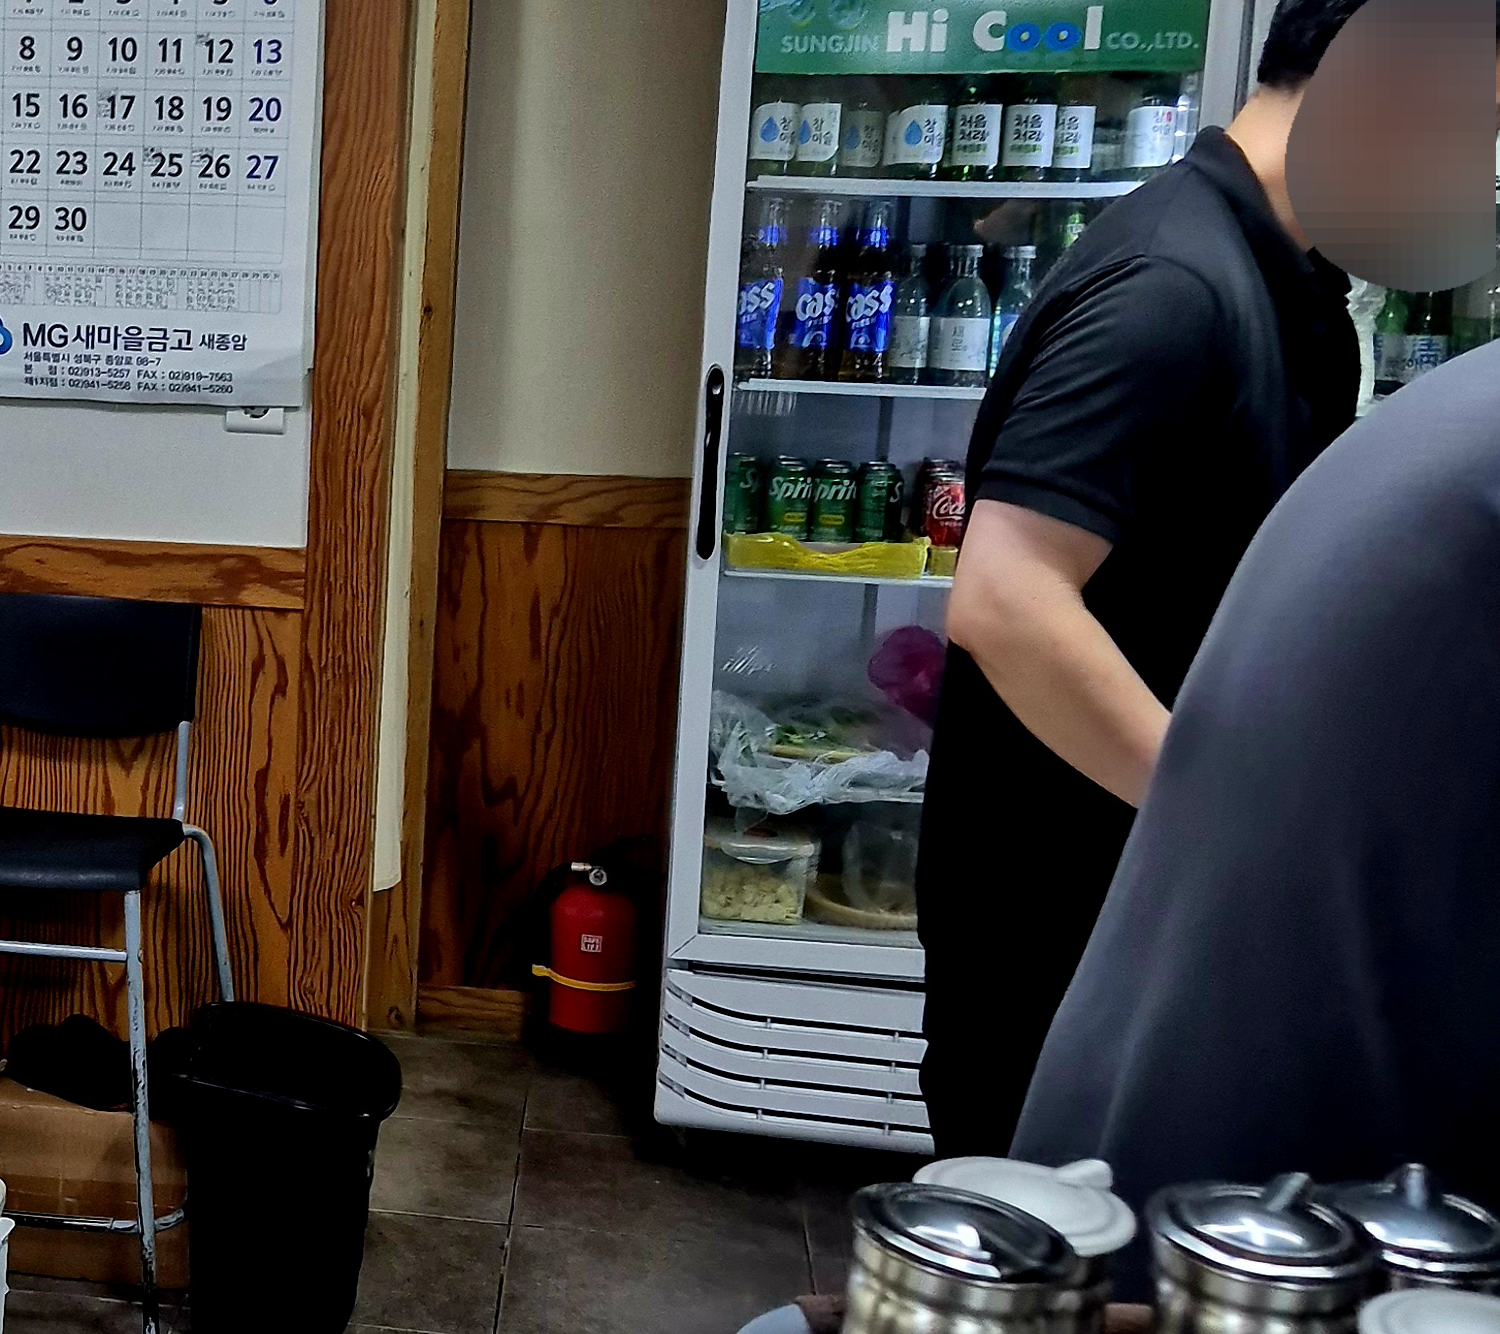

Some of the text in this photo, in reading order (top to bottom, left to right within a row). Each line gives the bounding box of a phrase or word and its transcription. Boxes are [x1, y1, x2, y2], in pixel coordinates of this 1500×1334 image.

[781, 34, 879, 54] SUNGJIN
[886, 8, 950, 54] Hi
[973, 6, 1103, 53] Cool
[18, 35, 36, 61] 8
[66, 35, 83, 62] 9
[107, 36, 138, 63] 10
[158, 37, 183, 64] 11
[204, 38, 234, 64] 12
[252, 38, 283, 65] 13
[11, 92, 41, 118] 15
[58, 93, 89, 119] 16
[107, 93, 136, 120] 17
[154, 95, 185, 121] 18
[202, 95, 233, 122] 19
[248, 96, 282, 123] 20
[8, 148, 42, 175] 22
[55, 149, 88, 176] 23
[102, 151, 137, 177] 24
[150, 153, 184, 178] 25
[200, 154, 231, 180] 26
[245, 154, 279, 181] 27
[8, 204, 41, 231] 29
[54, 206, 88, 232] 30
[22, 322, 248, 353] MG새마을금고 새종암
[137, 370, 157, 380] FAX
[137, 381, 157, 391] FAX
